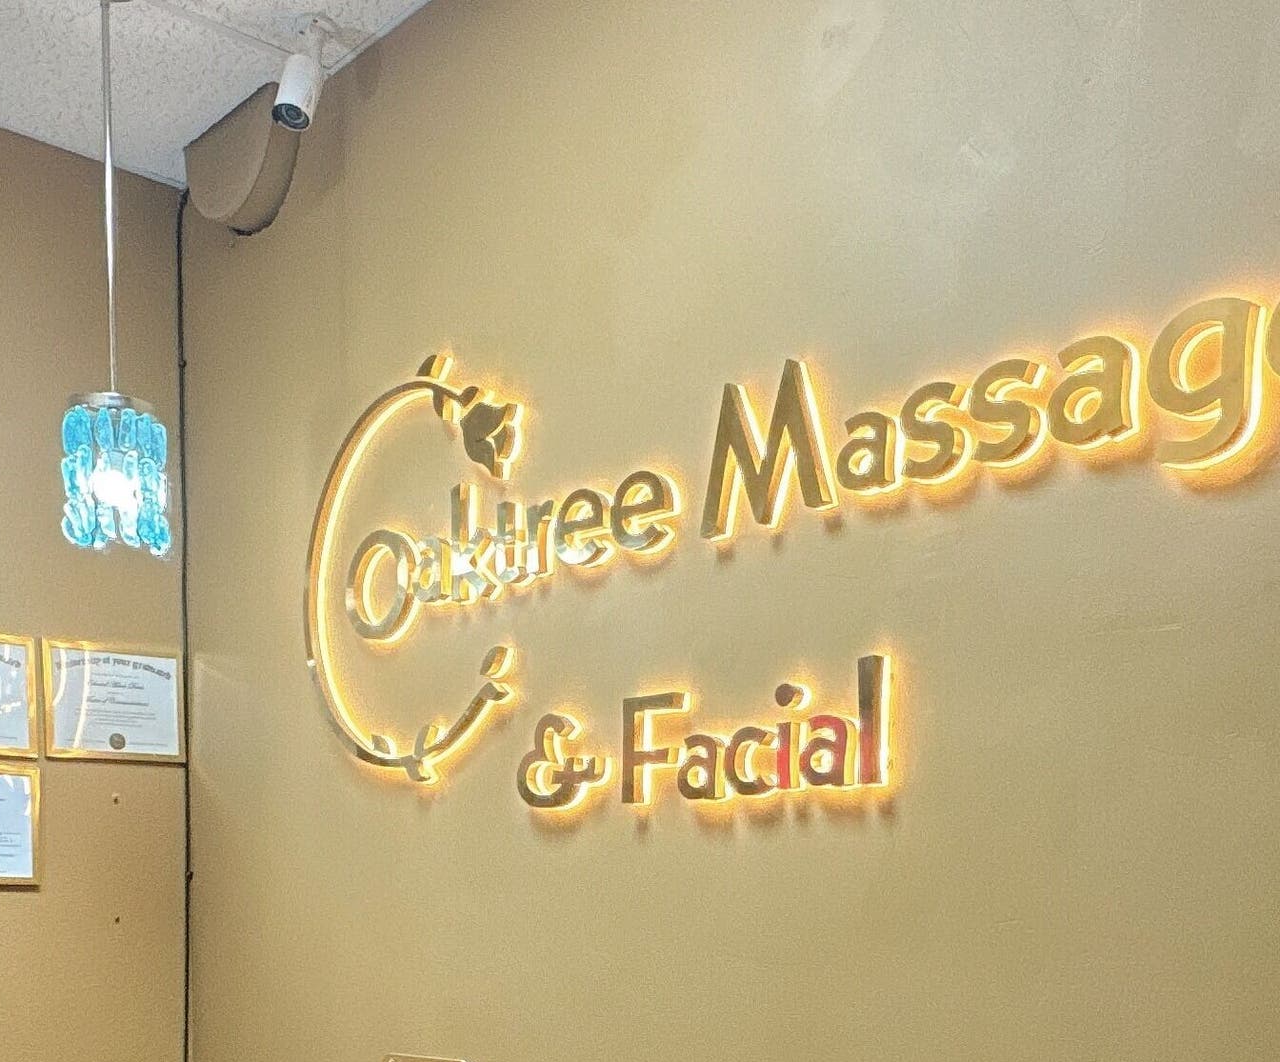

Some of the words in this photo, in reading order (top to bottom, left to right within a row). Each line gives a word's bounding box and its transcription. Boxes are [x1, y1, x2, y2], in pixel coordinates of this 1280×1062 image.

[346, 471, 682, 641] Oaktree
[517, 714, 612, 809] &
[622, 654, 891, 806] Facial
